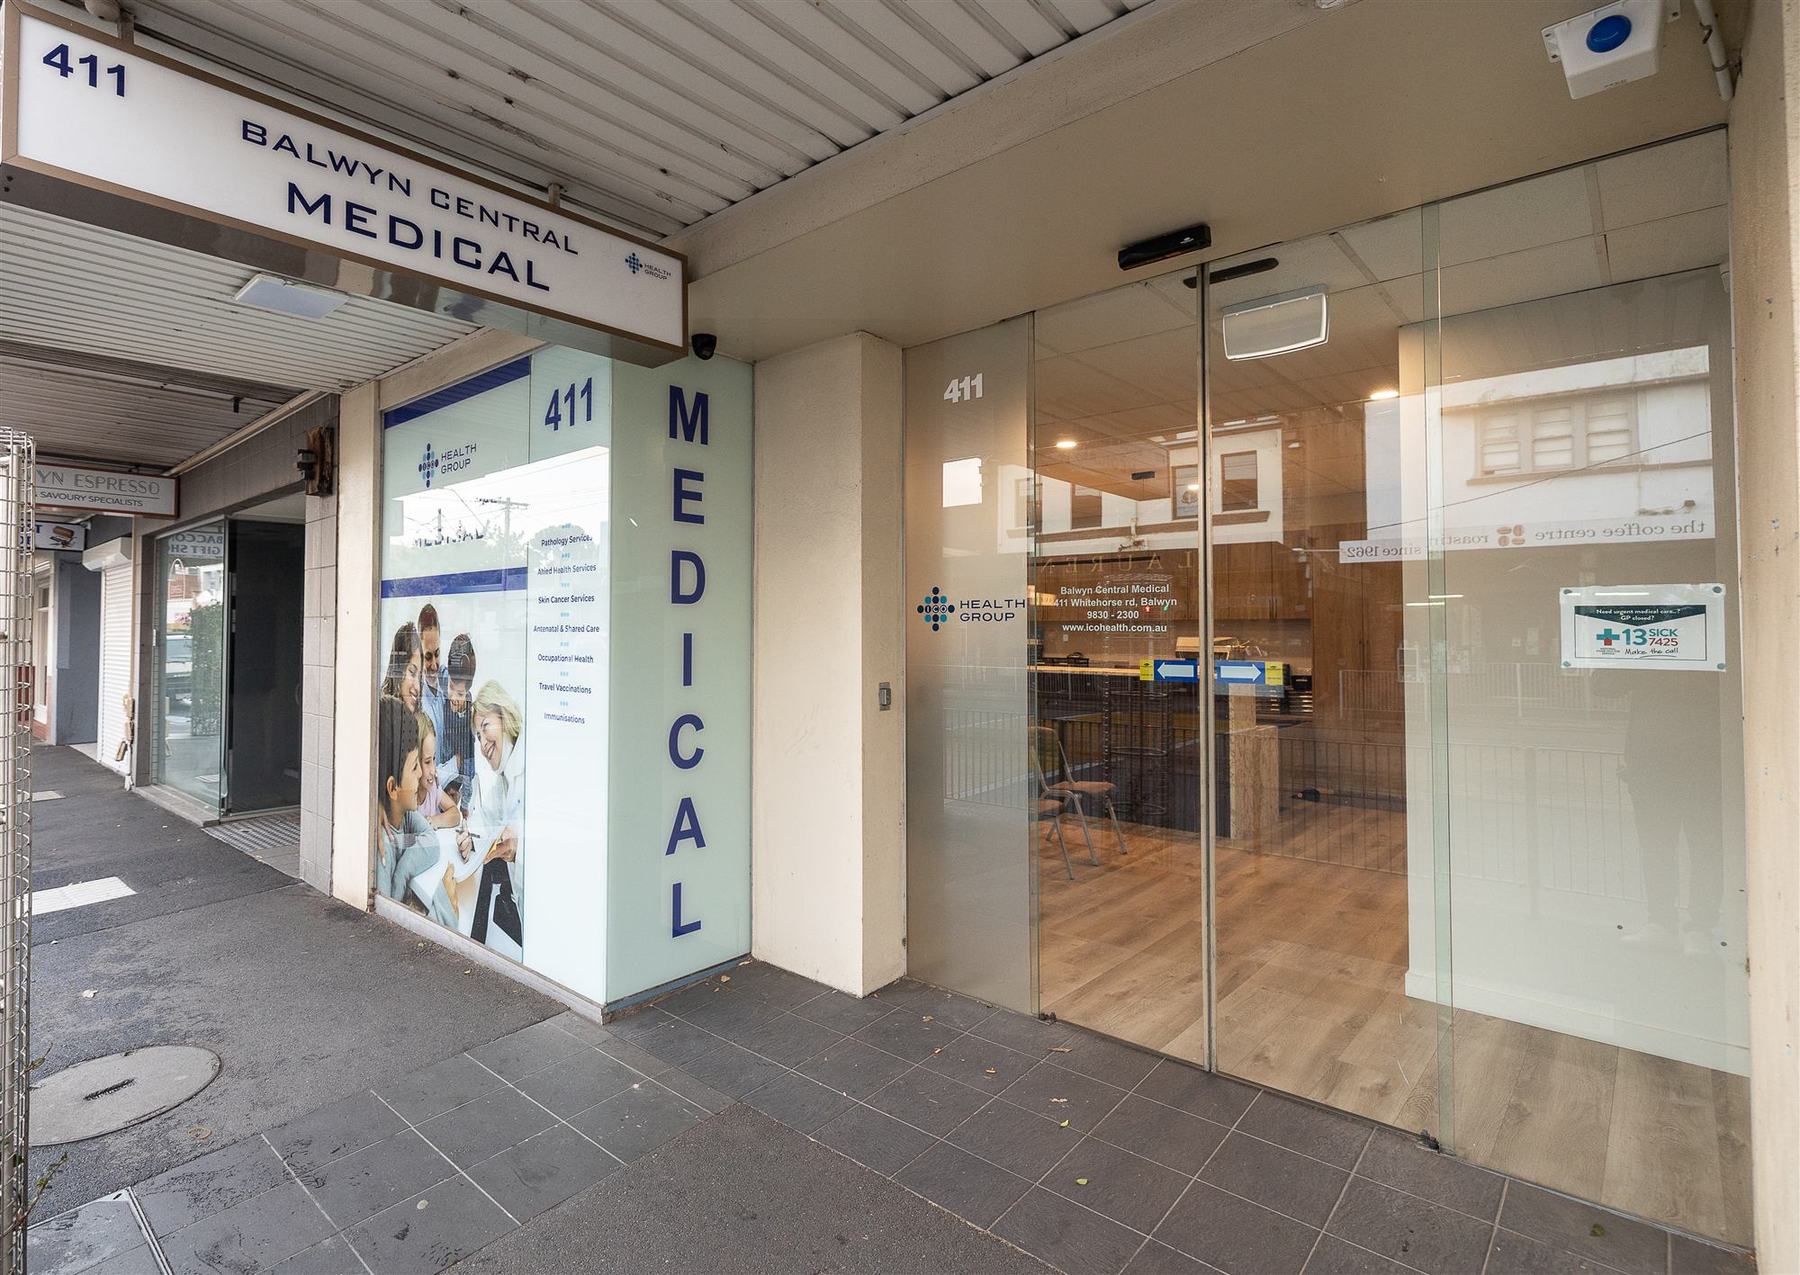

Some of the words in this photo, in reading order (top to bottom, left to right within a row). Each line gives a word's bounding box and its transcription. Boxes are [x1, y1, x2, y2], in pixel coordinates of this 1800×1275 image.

[42, 43, 125, 97] 411
[242, 119, 411, 198] BALWYN
[430, 187, 579, 255] CENTRAL
[287, 181, 550, 292] MEDICAL
[644, 263, 672, 277] HEALTH
[644, 269, 668, 280] GROUP
[944, 373, 983, 403] 411
[544, 377, 592, 431] 411
[441, 443, 477, 461] HEALTH
[441, 458, 471, 474] GROUP
[74, 473, 160, 495] ESPRESSO
[40, 491, 87, 502] SAVOURY
[88, 496, 144, 507] SPECIALISTS
[541, 537, 568, 547] Pathology
[553, 565, 571, 575] Health
[572, 563, 597, 573] Services
[1060, 586, 1093, 596] Balwyn
[1095, 585, 1129, 595] Central
[1131, 584, 1170, 593] Medical
[538, 595, 550, 604] Skin
[550, 595, 570, 604] Cancer
[570, 594, 595, 603] Services
[959, 599, 1026, 609] HEALTH
[1054, 598, 1068, 607] 411
[1070, 598, 1122, 607] Whitehorse
[1125, 598, 1138, 607] rd,
[1140, 597, 1178, 608] Balwyn
[959, 612, 1016, 622] GROUP
[1087, 610, 1109, 619] 9830
[1117, 610, 1140, 619] 2300
[533, 625, 559, 633] Antenatal
[560, 625, 564, 633] &
[565, 625, 585, 633] Shared
[586, 625, 600, 633] Care
[1062, 622, 1168, 632] www.icohealth.com.au
[1648, 628, 1678, 637] SICK
[1622, 628, 1648, 646] 13
[1648, 637, 1679, 646] 7425
[1650, 647, 1663, 655] the
[537, 653, 573, 663] Occupational
[574, 655, 594, 663] Health
[665, 385, 709, 938] MEDICAL
[539, 682, 555, 691] Travel
[556, 683, 592, 694] Vaccinations
[543, 712, 585, 724] Immunisations
